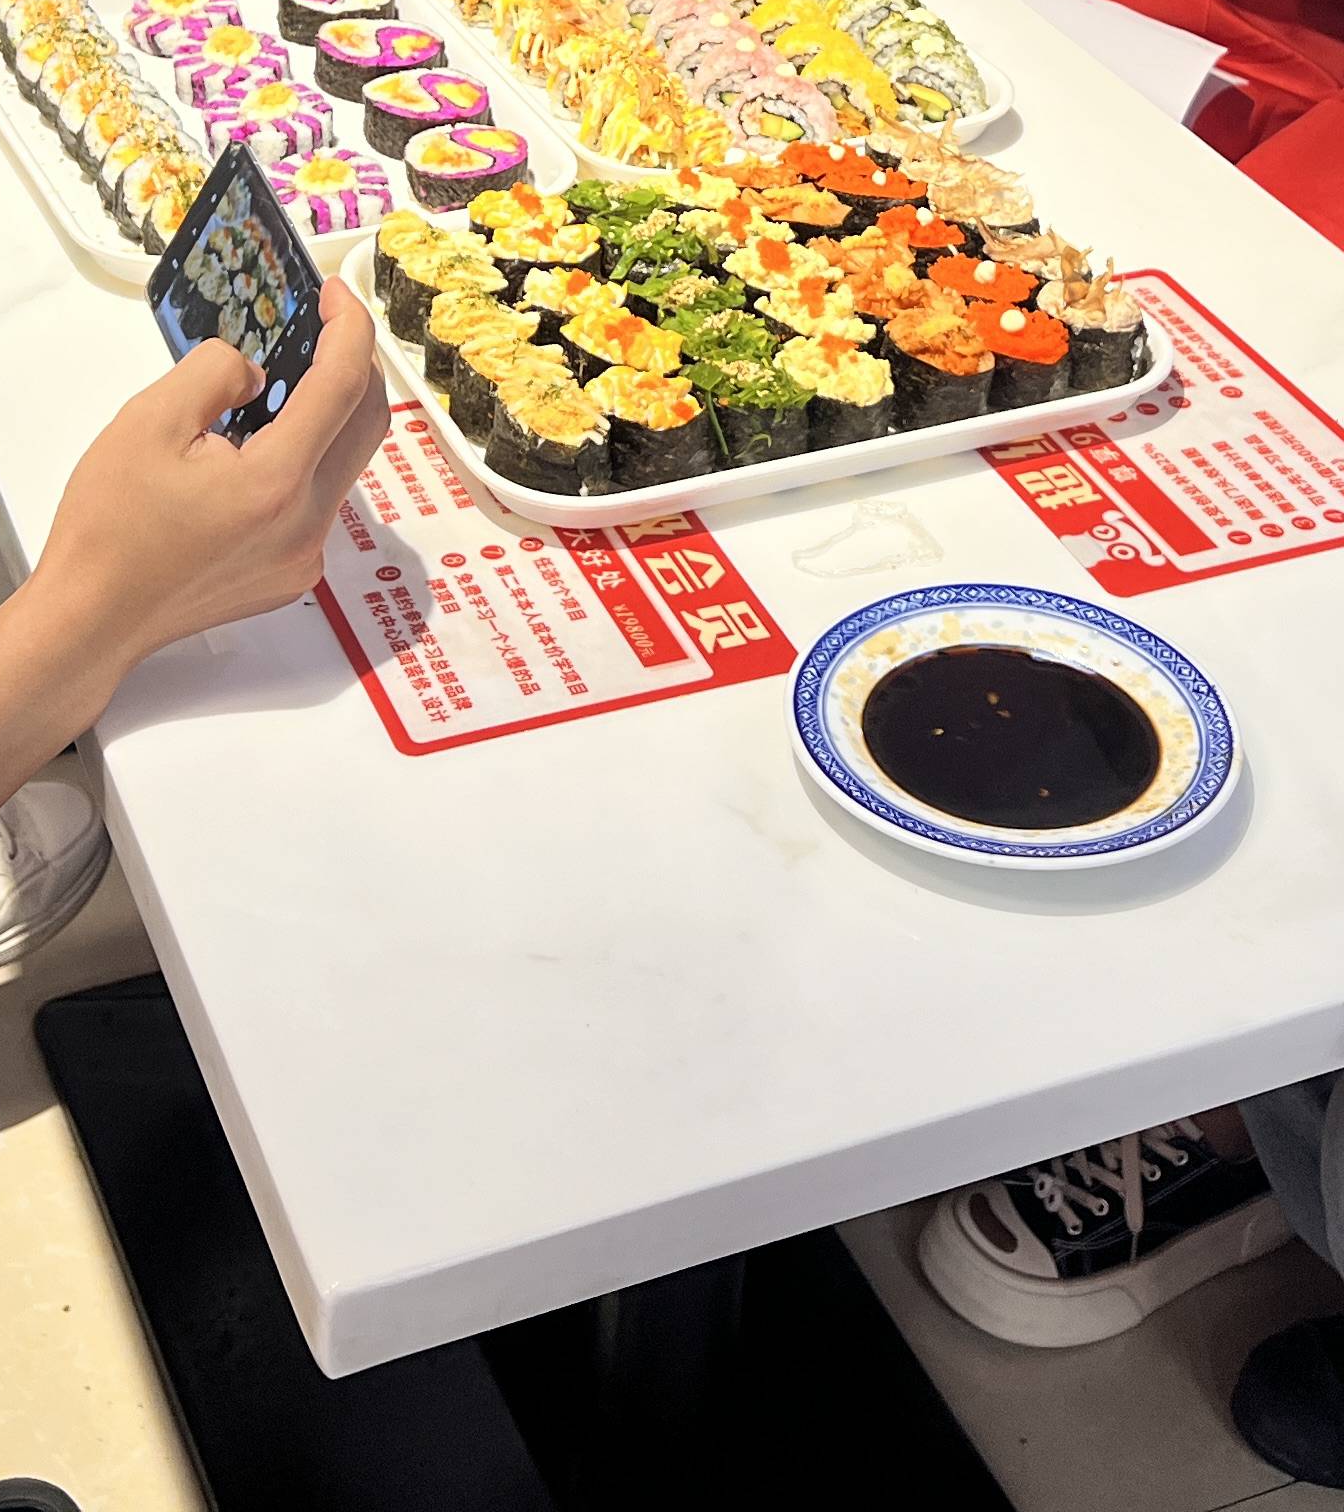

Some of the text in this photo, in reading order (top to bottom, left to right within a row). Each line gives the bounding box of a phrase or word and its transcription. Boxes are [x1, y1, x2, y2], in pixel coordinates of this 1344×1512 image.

[535, 558, 587, 621] 任选6个项目
[562, 526, 628, 592] 大好处
[458, 574, 539, 695] 免费学习一个火爆的品
[496, 566, 587, 695] 第二年本人成本价学项目
